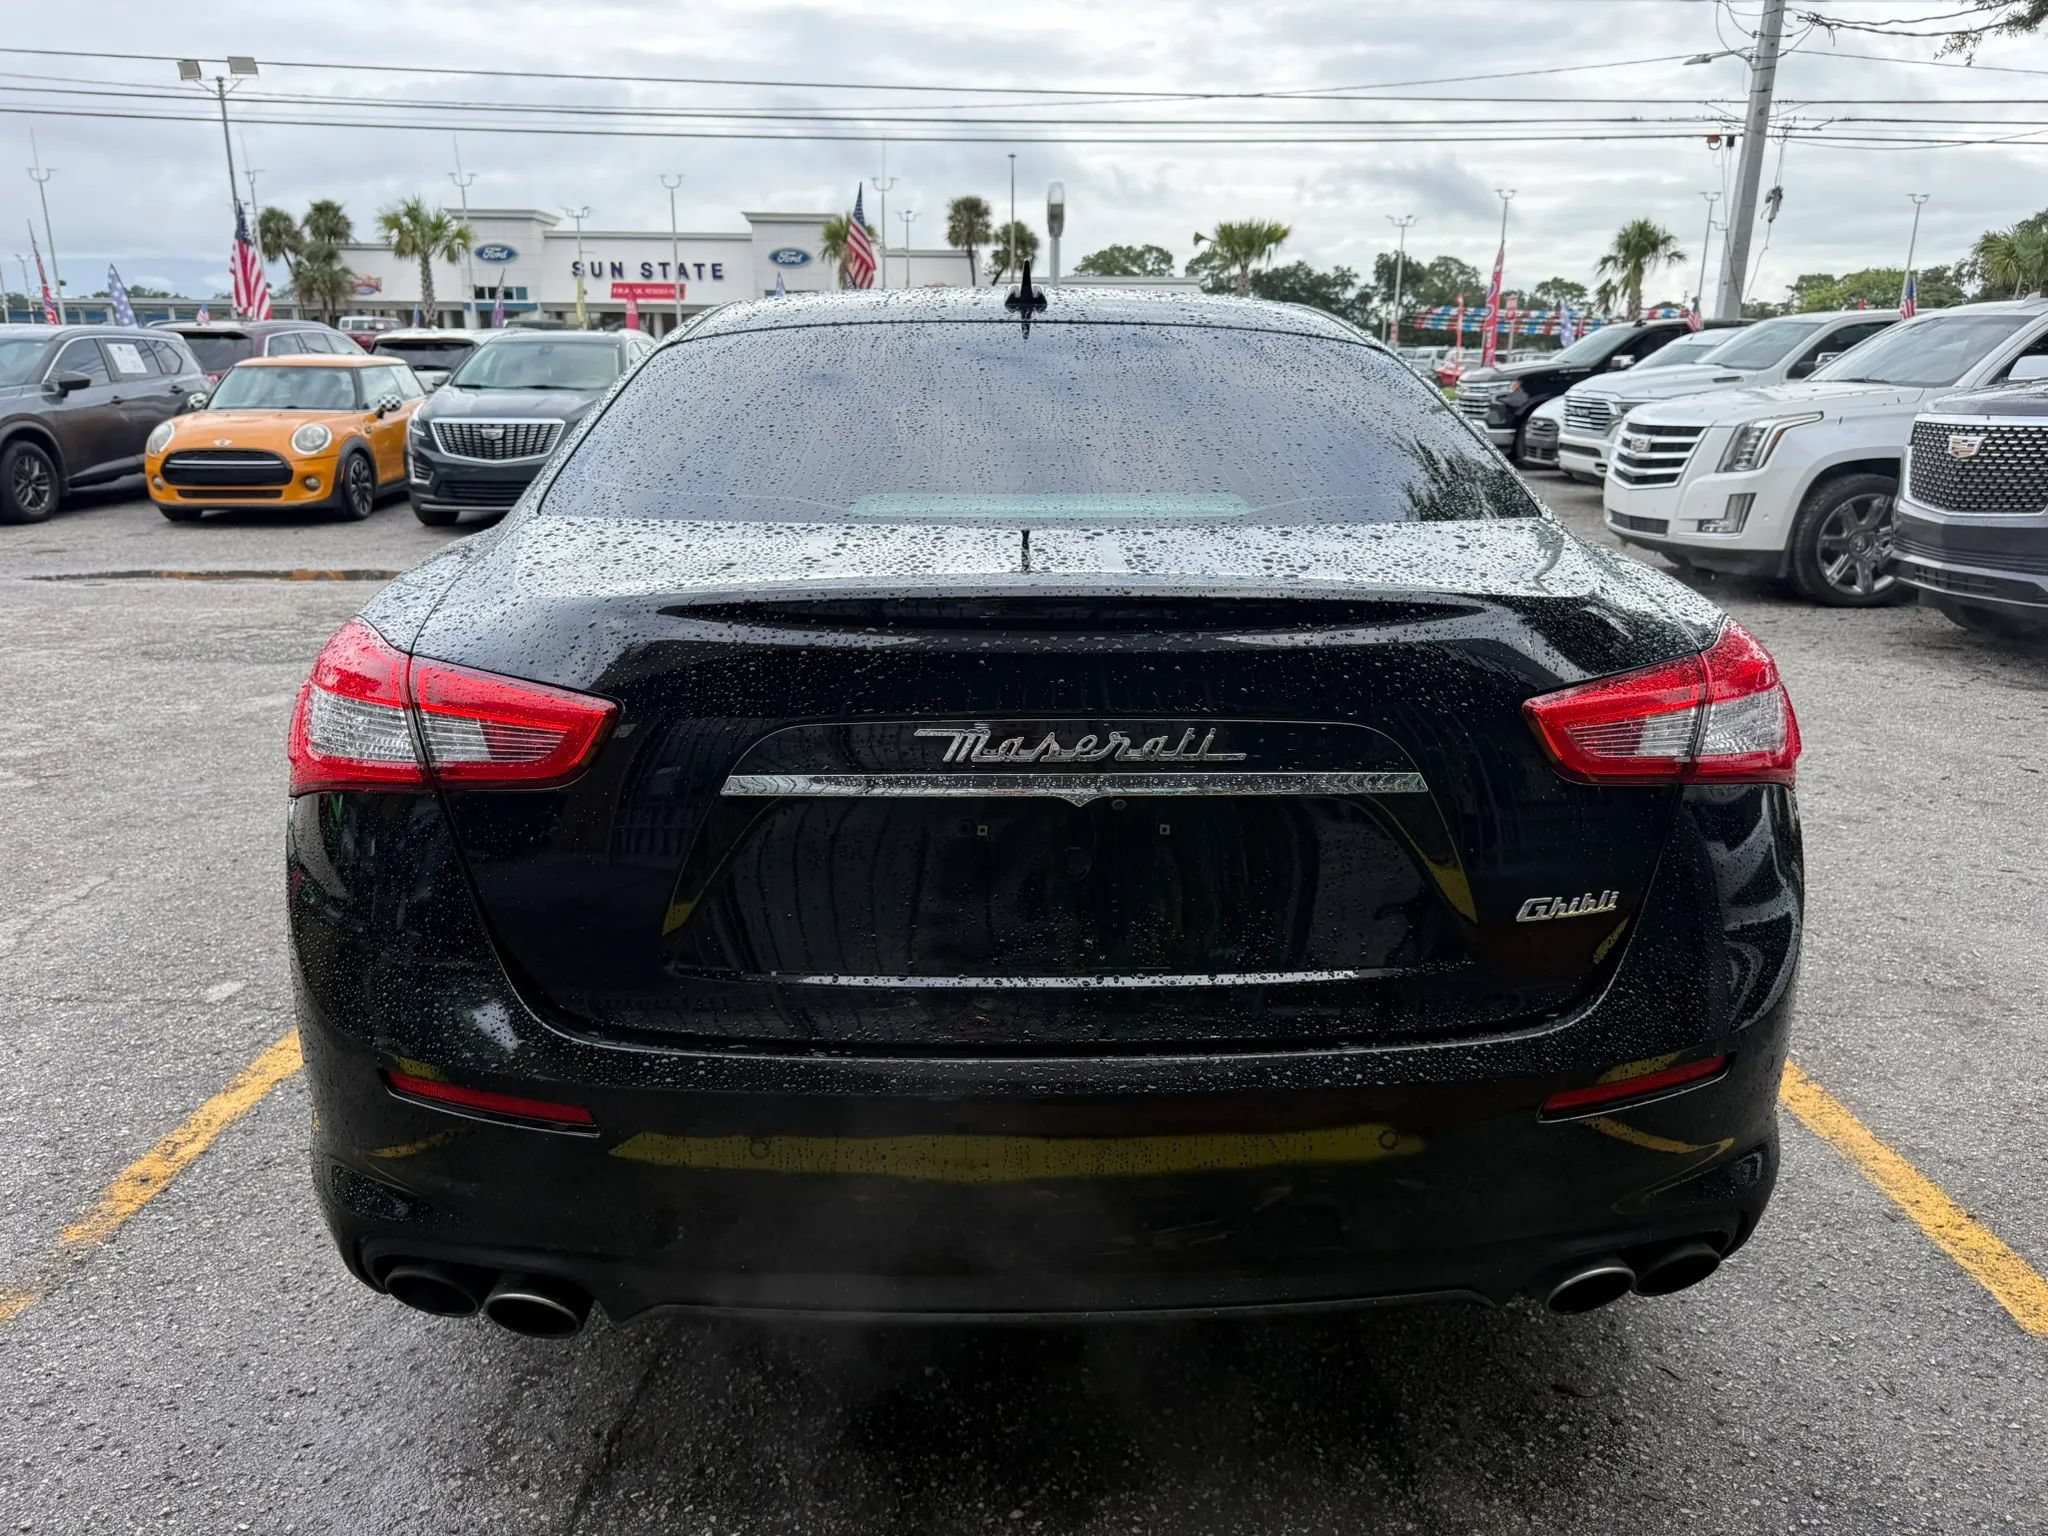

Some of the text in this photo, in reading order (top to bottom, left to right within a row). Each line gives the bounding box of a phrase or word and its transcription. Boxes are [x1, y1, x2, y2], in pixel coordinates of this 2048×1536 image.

[482, 247, 508, 259] Ford
[777, 251, 803, 264] Ford
[572, 261, 724, 280] SUN STATE
[914, 728, 1247, 763] Maserati
[1516, 890, 1619, 922] Ghibli
